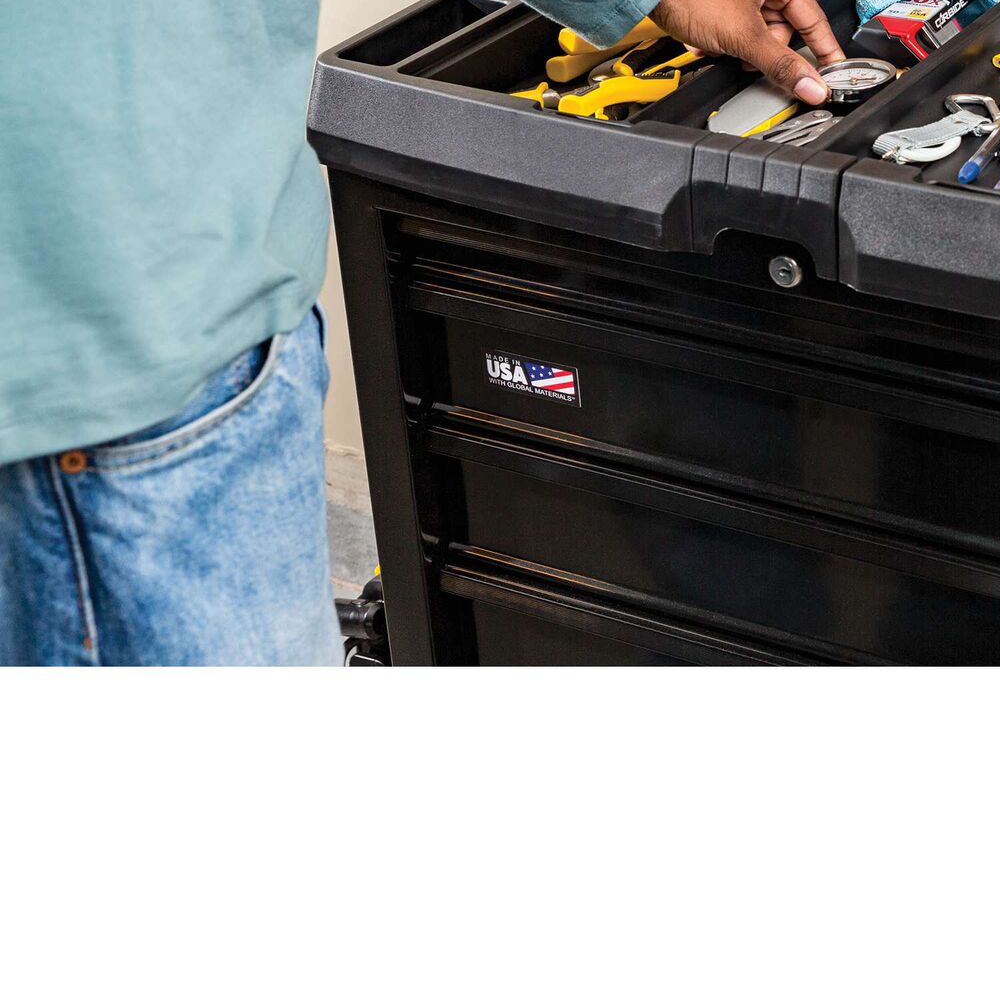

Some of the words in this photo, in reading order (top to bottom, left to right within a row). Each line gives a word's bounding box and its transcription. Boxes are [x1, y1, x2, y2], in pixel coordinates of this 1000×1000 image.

[485, 353, 509, 364] MADE
[486, 359, 529, 386] USA
[488, 377, 506, 387] WITH
[506, 381, 534, 393] GLOBAL
